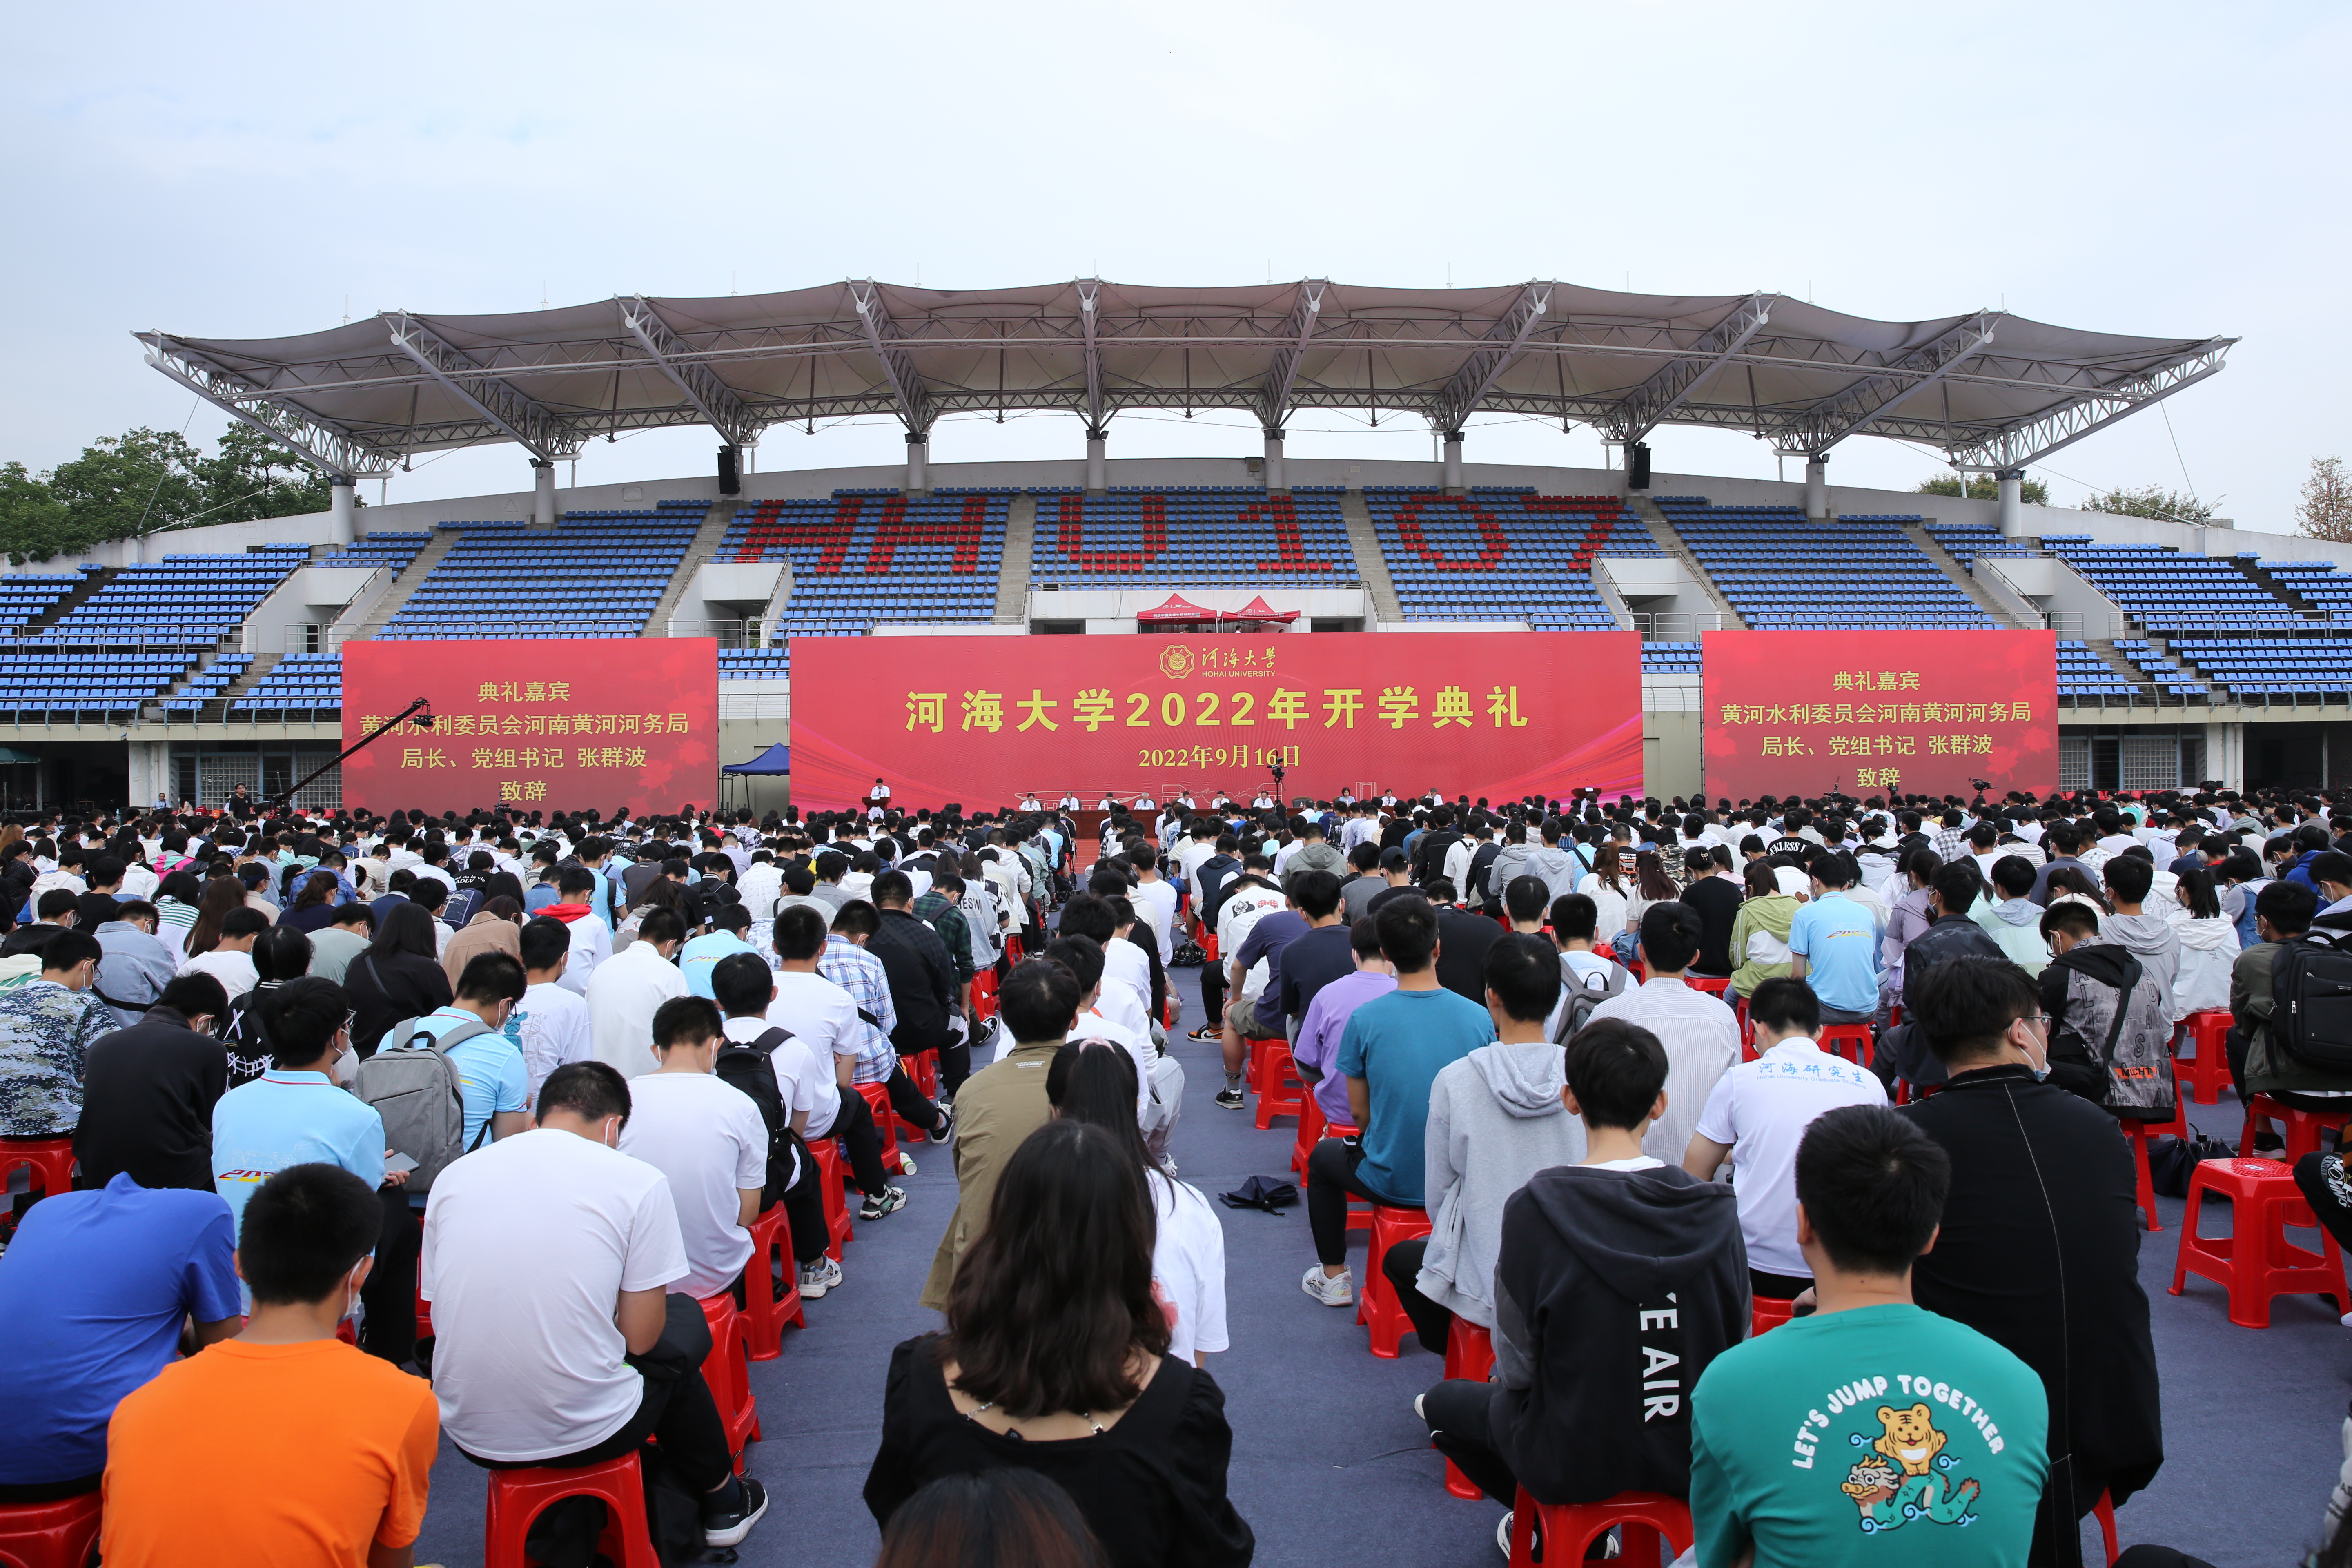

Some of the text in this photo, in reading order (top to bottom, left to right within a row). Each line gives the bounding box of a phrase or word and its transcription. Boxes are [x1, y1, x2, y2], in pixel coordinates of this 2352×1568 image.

[477, 681, 571, 702] 典礼嘉宾
[1833, 670, 1921, 691] 典礼嘉宾
[904, 685, 1529, 734] 河海大学2022年开学典礼
[1720, 702, 2031, 725] 黄河水利委员会河南黄河河务局
[1138, 744, 1301, 770] 2022年9月16日
[1761, 734, 1993, 757] 局长、党组书记 张群波
[401, 746, 647, 769] 局长、党组书记 张群波
[1856, 767, 1900, 788] 致辞
[501, 780, 547, 802] 致辞
[1758, 1062, 1864, 1083] 河海研究生
[1842, 1078, 1866, 1089] Students
[1642, 1346, 1679, 1423] AIR
[1792, 1374, 2005, 1469] LET'S JUMP TOGETHER
